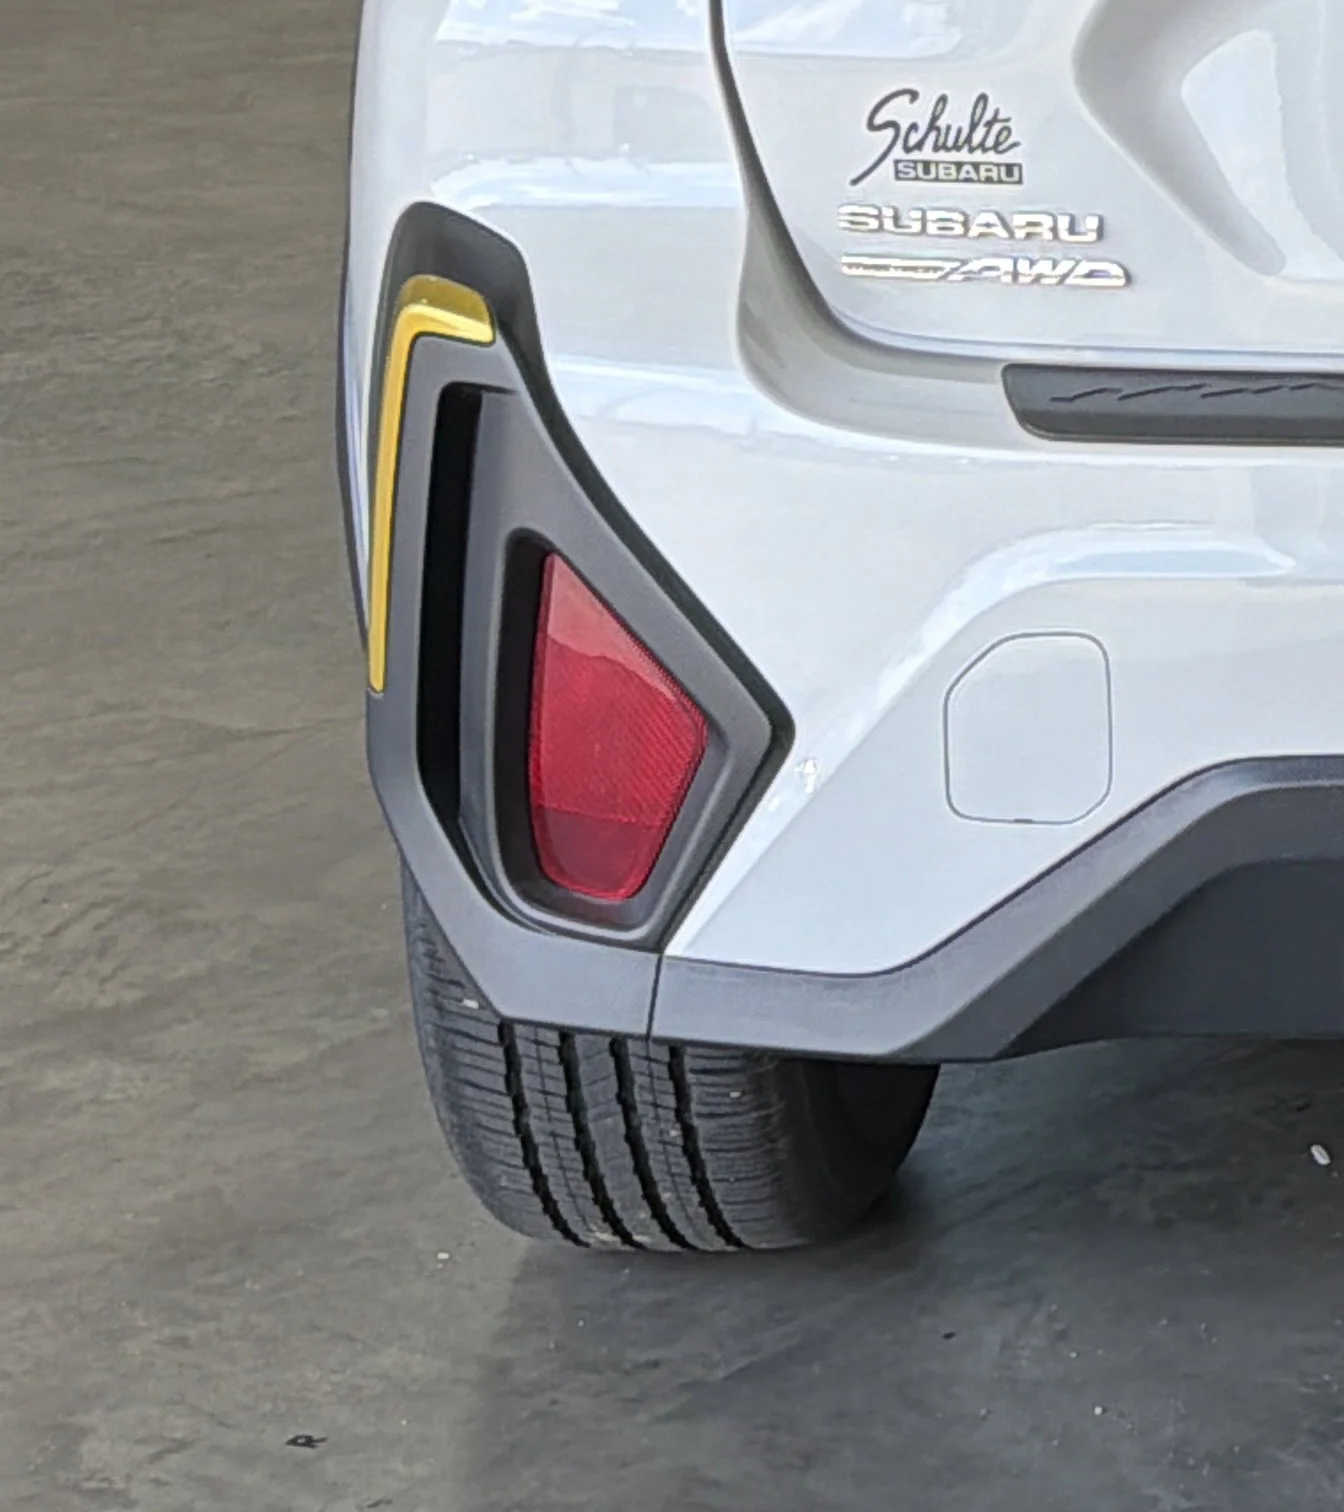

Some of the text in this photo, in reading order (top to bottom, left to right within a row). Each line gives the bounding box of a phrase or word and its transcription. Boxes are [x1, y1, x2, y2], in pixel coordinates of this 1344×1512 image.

[850, 87, 1022, 186] Schulte
[897, 161, 1021, 183] SUBARU
[836, 204, 1104, 242] SUBARU
[946, 255, 1132, 288] AWD
